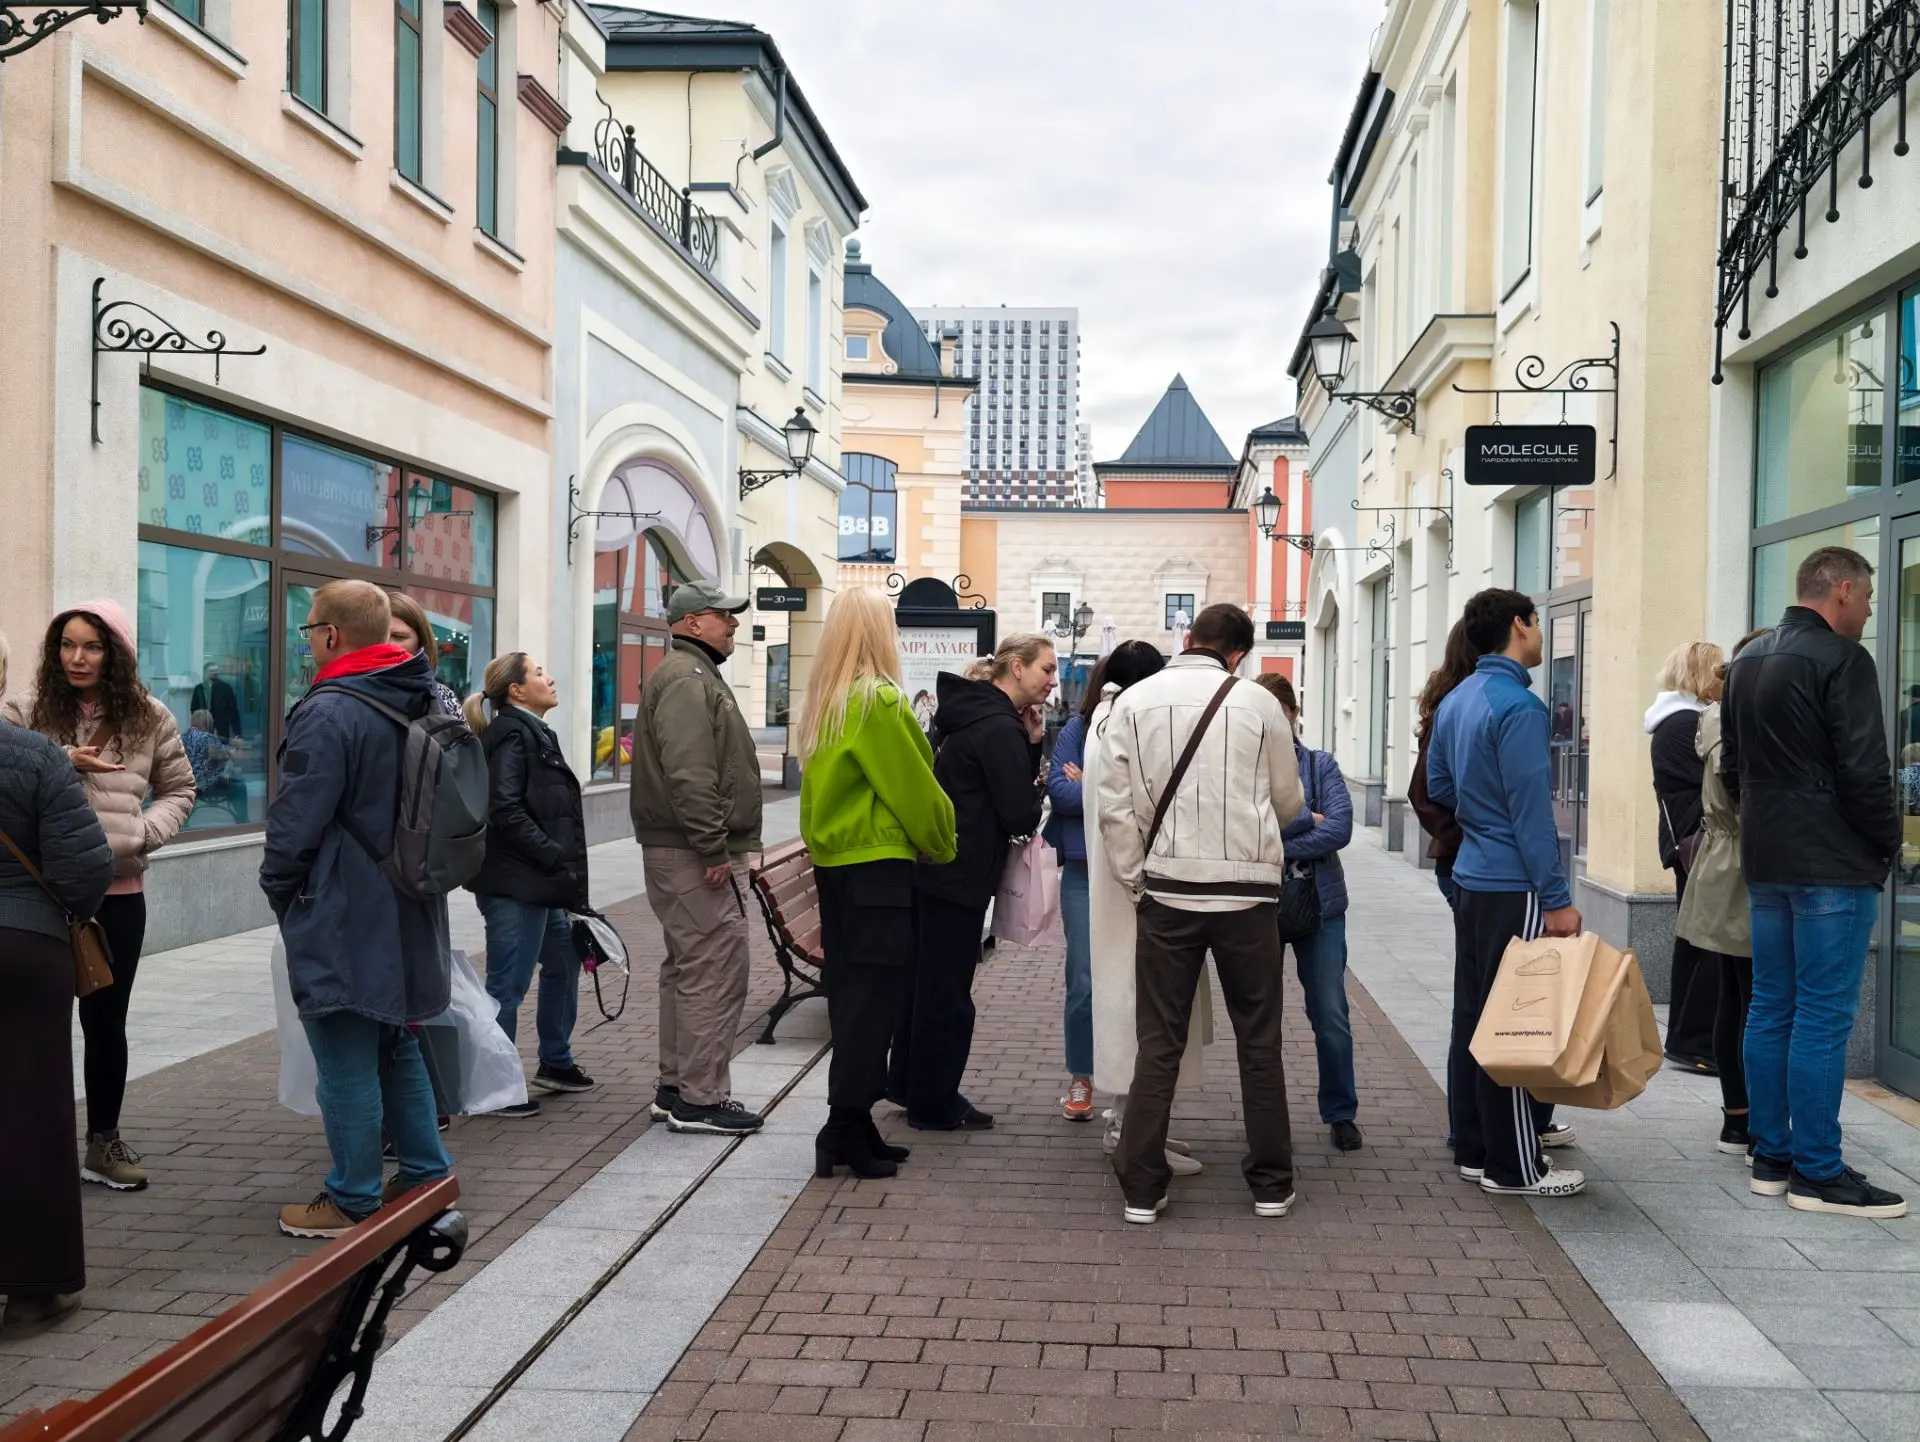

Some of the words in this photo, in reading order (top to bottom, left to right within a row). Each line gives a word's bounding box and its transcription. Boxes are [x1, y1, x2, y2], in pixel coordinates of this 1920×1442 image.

[1481, 444, 1579, 456] MOLECULE
[838, 515, 889, 536] B&B
[899, 641, 977, 654] MPLAYART
[1494, 1029, 1553, 1038] www.sportpoint.ru
[1538, 1183, 1576, 1195] crocs
